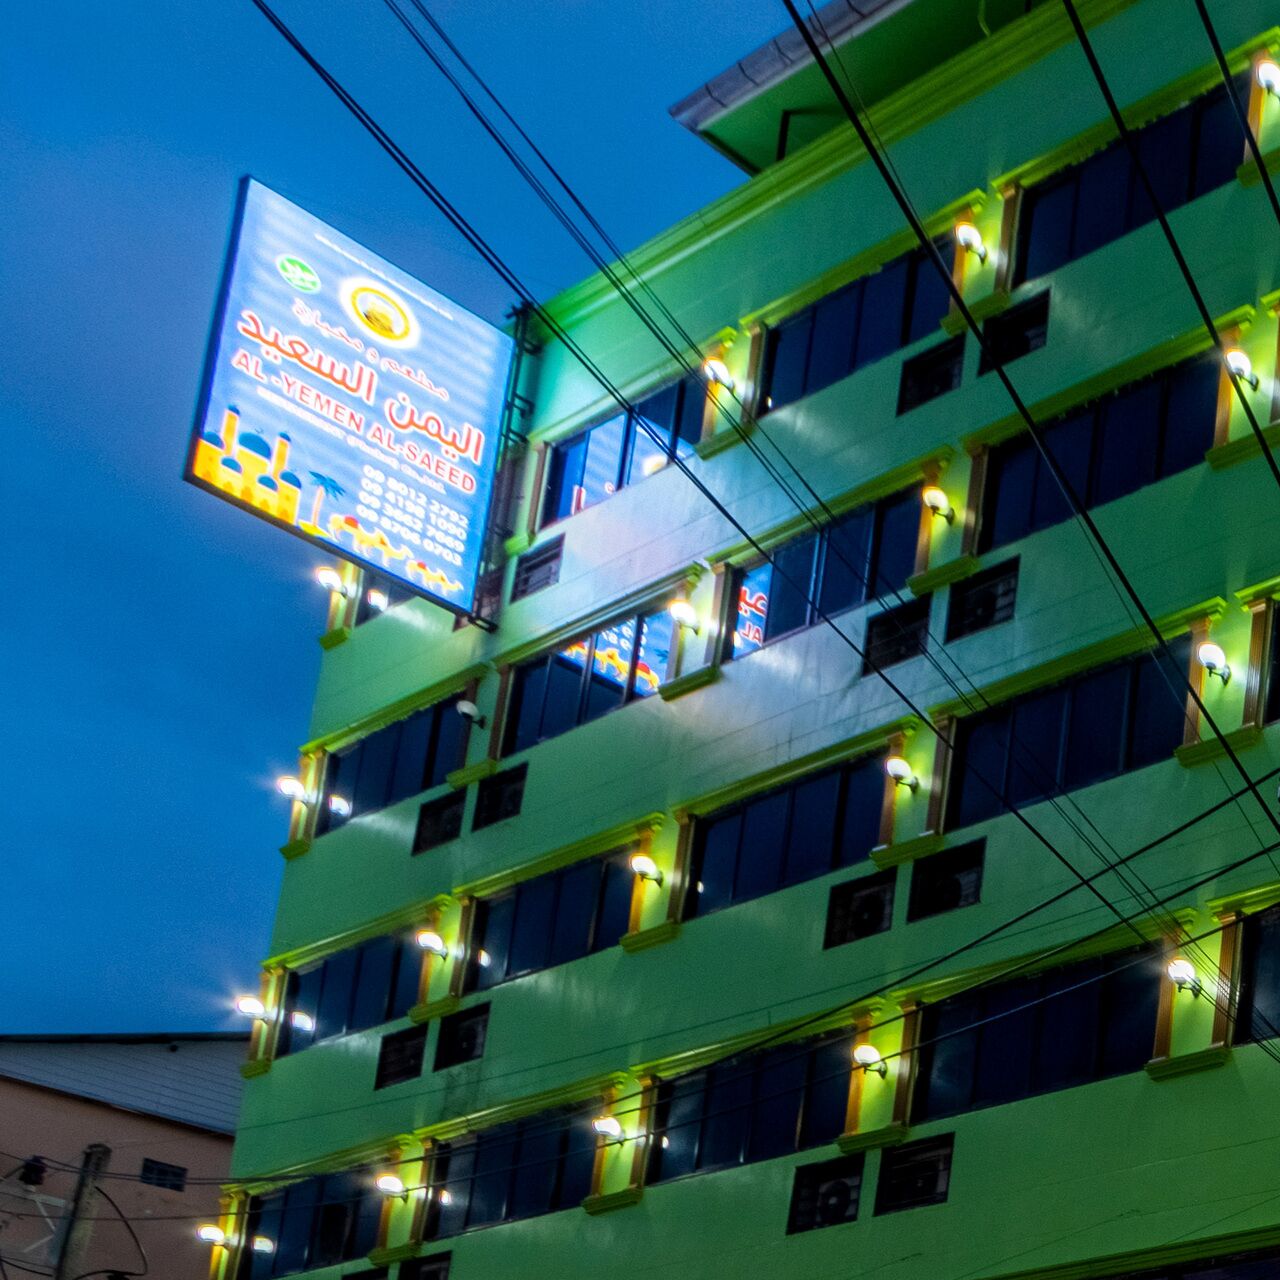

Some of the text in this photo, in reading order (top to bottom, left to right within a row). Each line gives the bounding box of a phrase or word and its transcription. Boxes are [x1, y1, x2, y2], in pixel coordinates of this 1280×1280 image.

[238, 309, 376, 404] السعيد
[370, 426, 475, 494] AL-SAEED
[383, 391, 485, 464] اليمن
